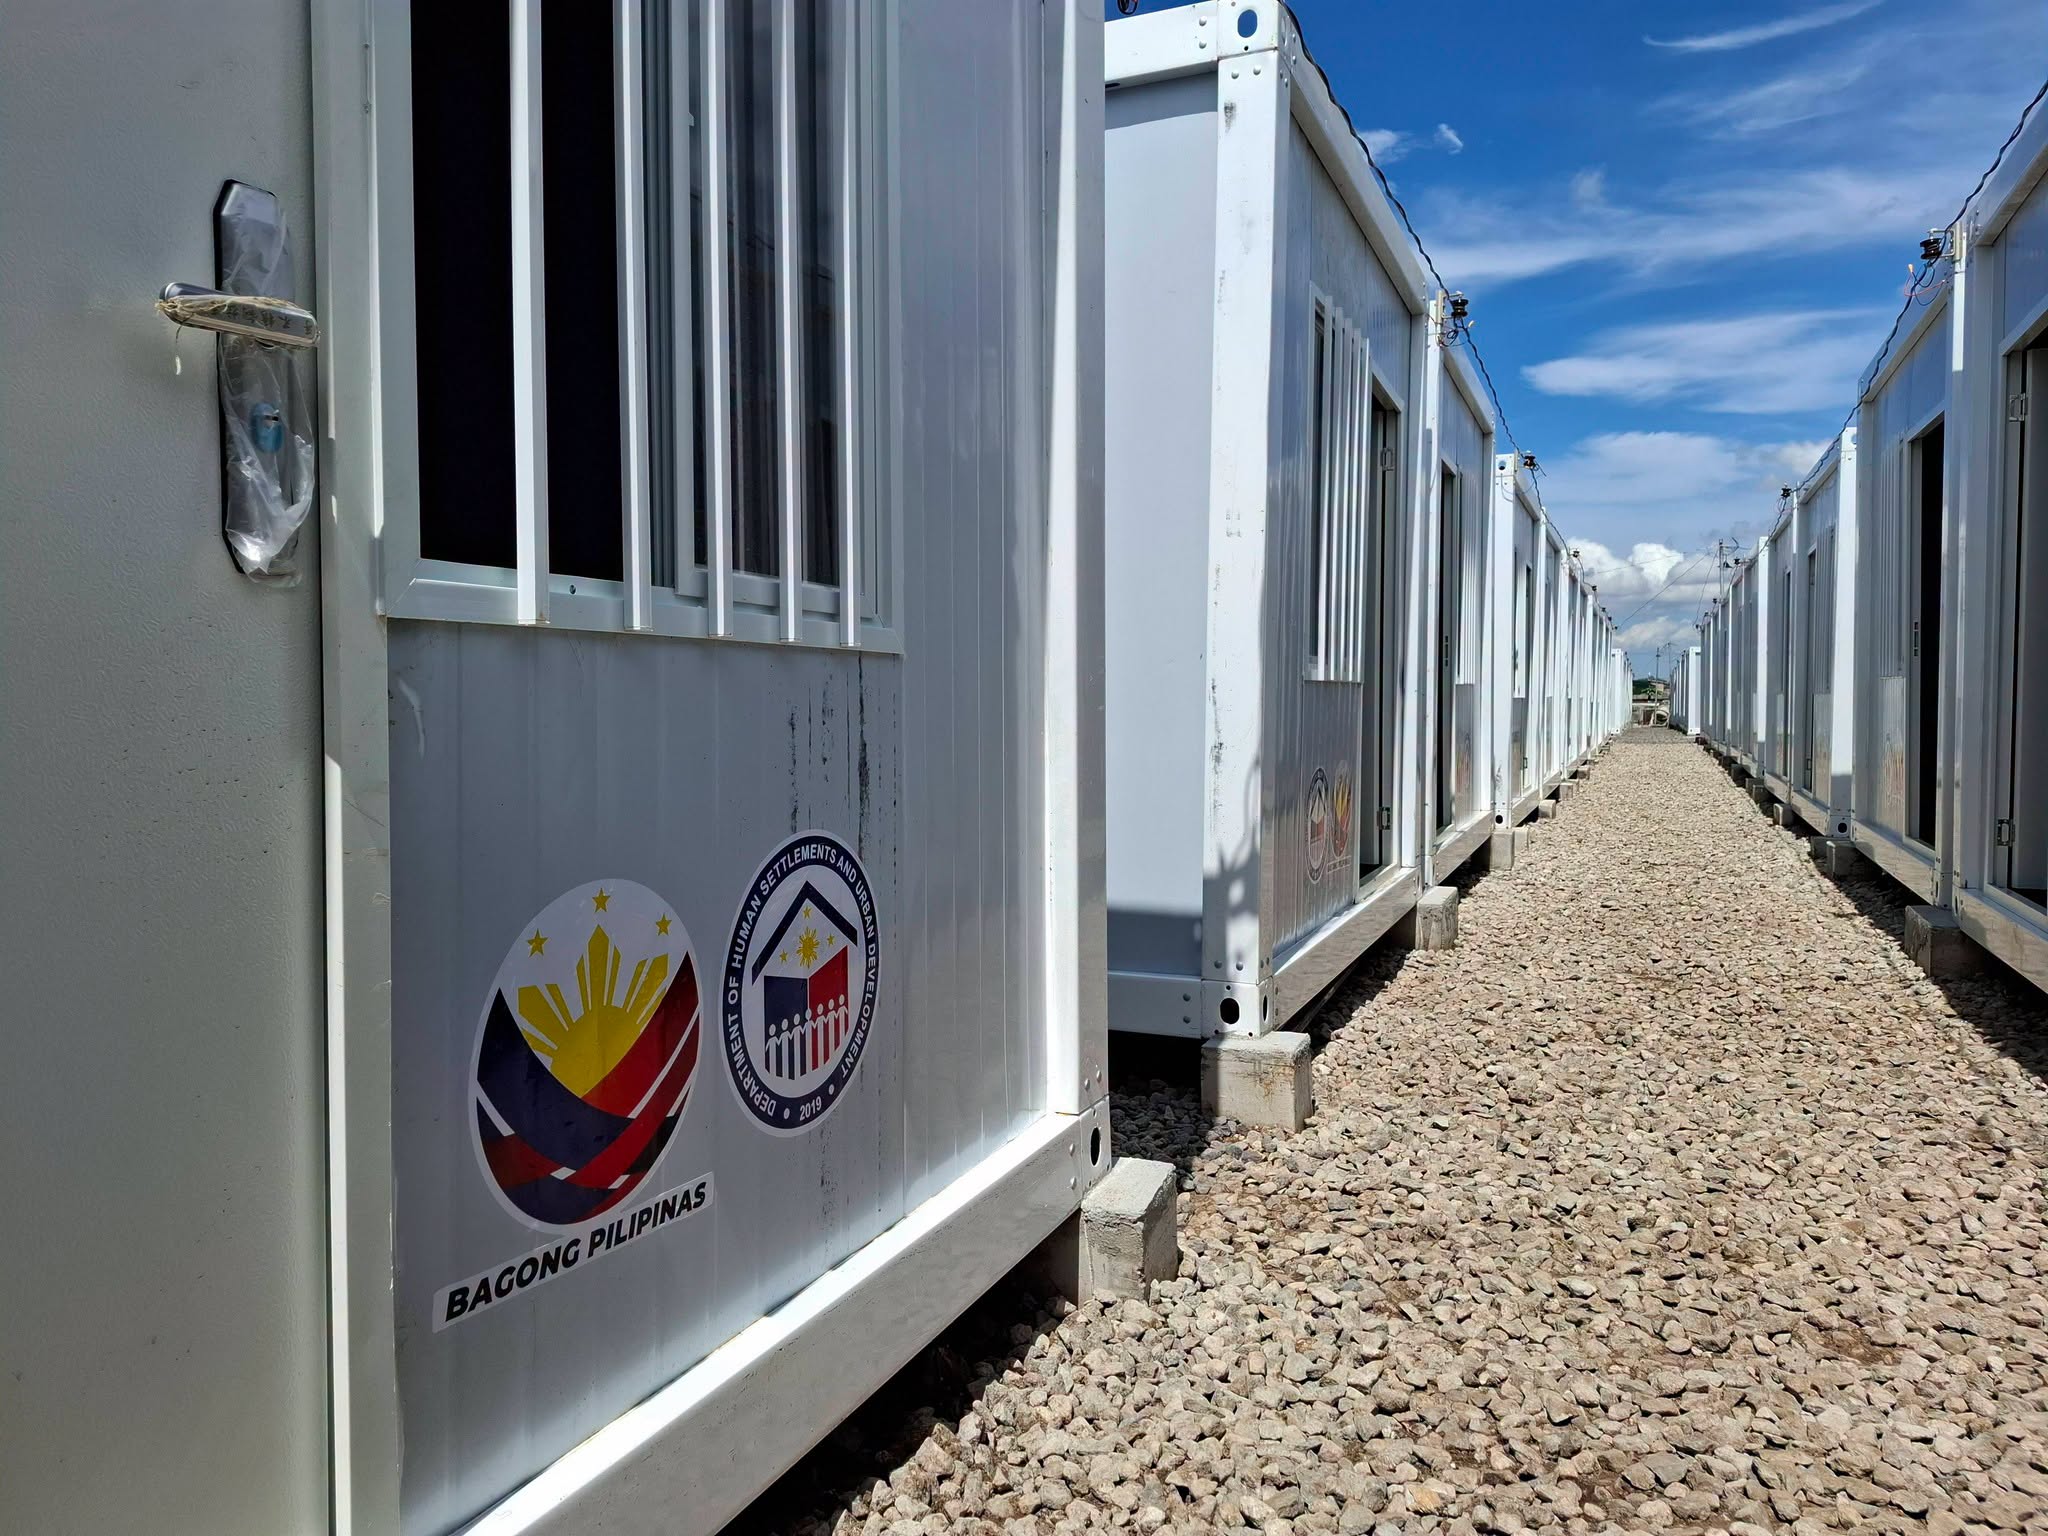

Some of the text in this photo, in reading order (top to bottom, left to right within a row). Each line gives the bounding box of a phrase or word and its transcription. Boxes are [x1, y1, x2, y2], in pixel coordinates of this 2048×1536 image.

[728, 844, 876, 1117] DEPARTMENT OF HUMAN SETTLEMENTS AND URBAN DEVELOPMENT
[799, 1099, 822, 1122] 2019
[445, 1181, 707, 1323] BAGONG PILIPINAS
